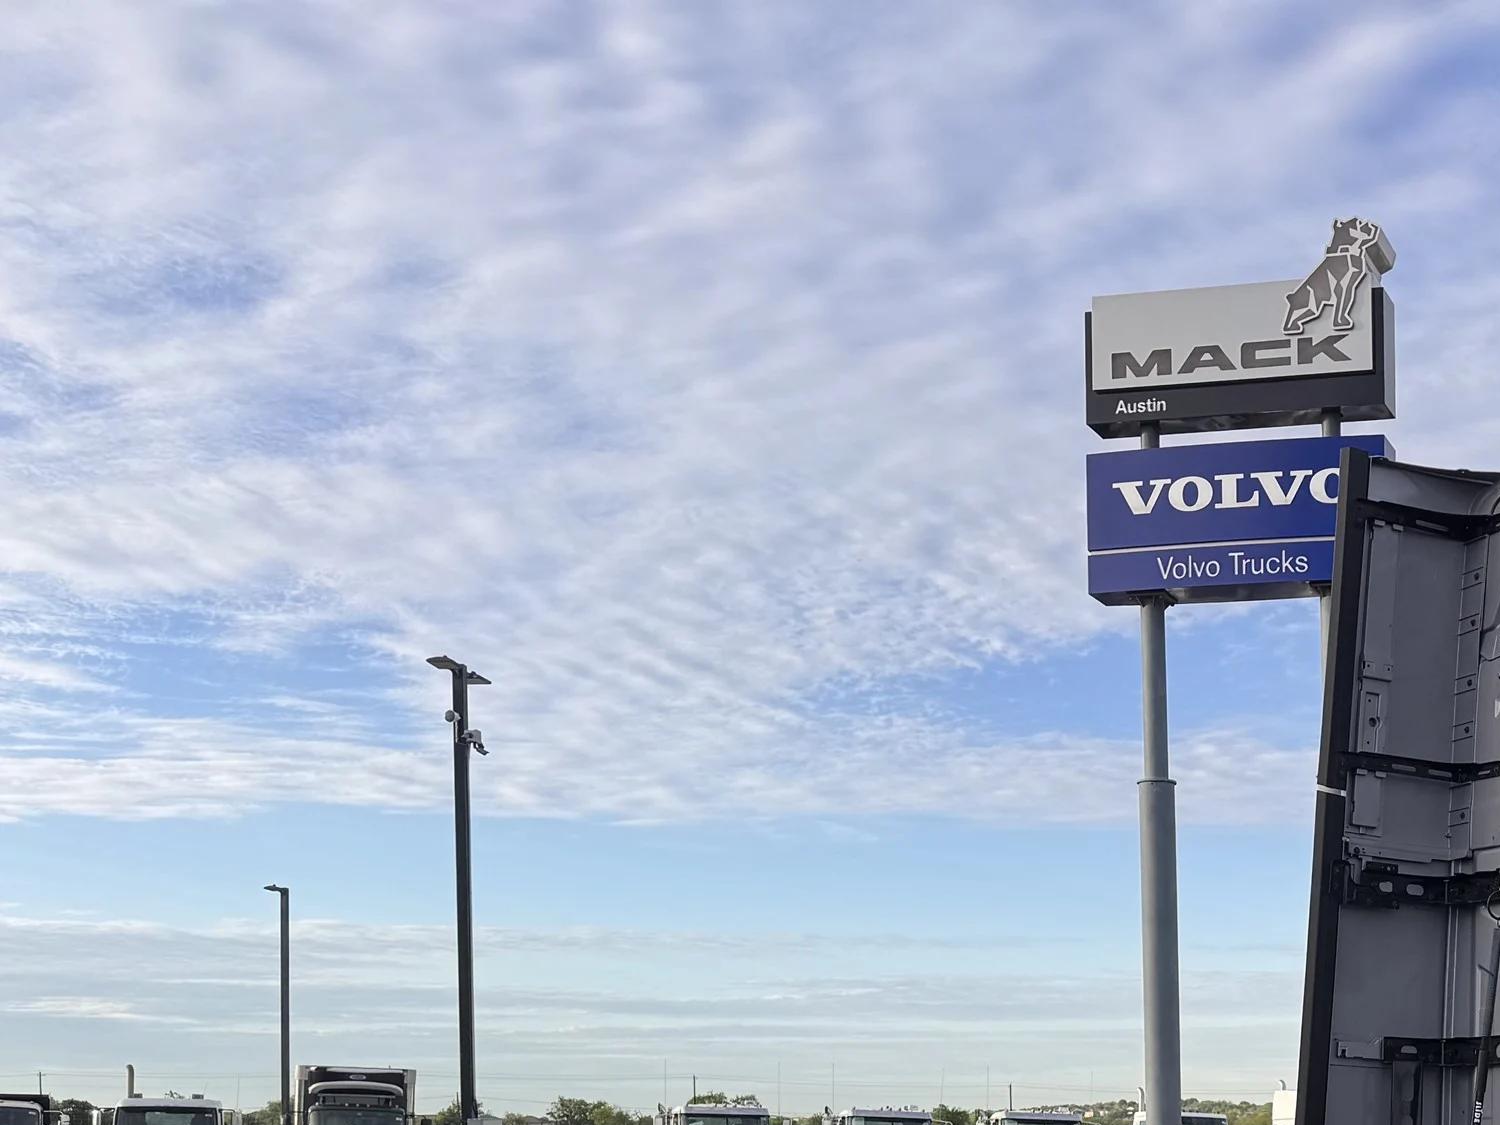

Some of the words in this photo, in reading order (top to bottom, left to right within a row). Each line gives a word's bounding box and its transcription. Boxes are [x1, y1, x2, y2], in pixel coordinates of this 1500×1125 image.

[1111, 333, 1352, 380] MACK
[1115, 398, 1167, 415] Austin
[1112, 467, 1341, 516] VOLVO
[1157, 555, 1220, 581] Volvo
[1228, 550, 1309, 576] Trucks
